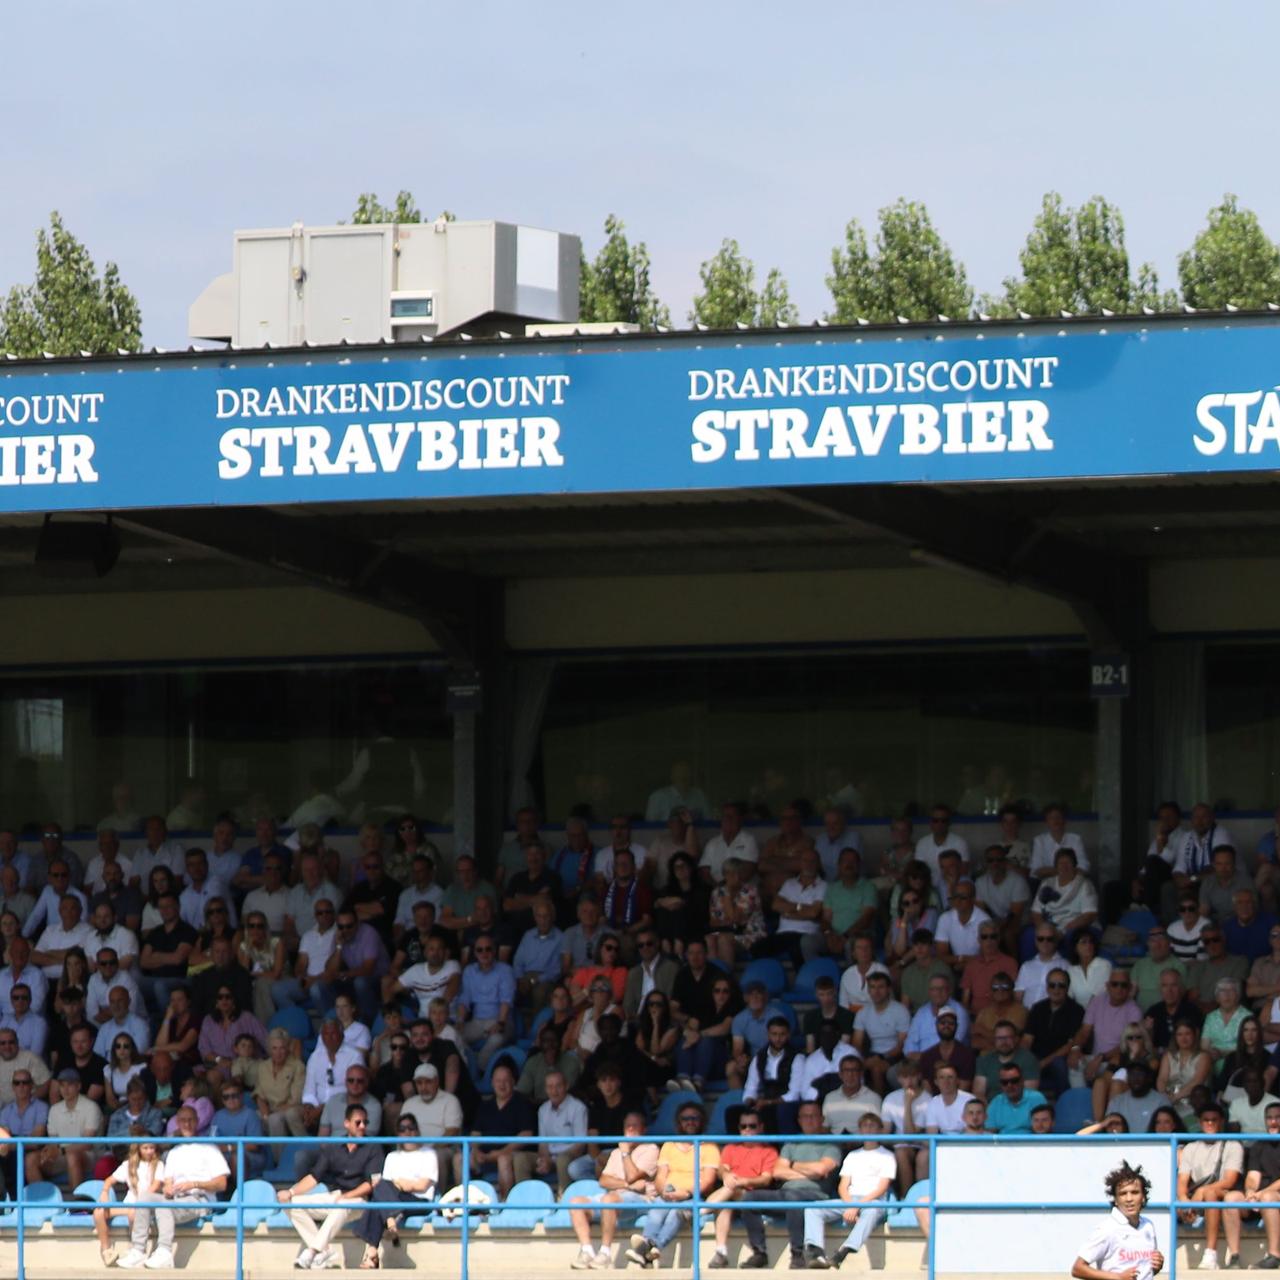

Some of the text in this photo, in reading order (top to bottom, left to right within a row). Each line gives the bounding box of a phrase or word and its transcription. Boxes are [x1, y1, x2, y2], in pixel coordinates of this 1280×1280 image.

[215, 374, 571, 419] DRANKENDISCOUNT
[687, 356, 1059, 401] DRANKENDISCOUNT
[0, 392, 104, 426] OUNT
[691, 400, 1055, 463] STRAVBIER
[218, 416, 565, 480] STRAVBIER
[1091, 664, 1128, 686] B2-1
[1119, 1248, 1152, 1261] Sunw
